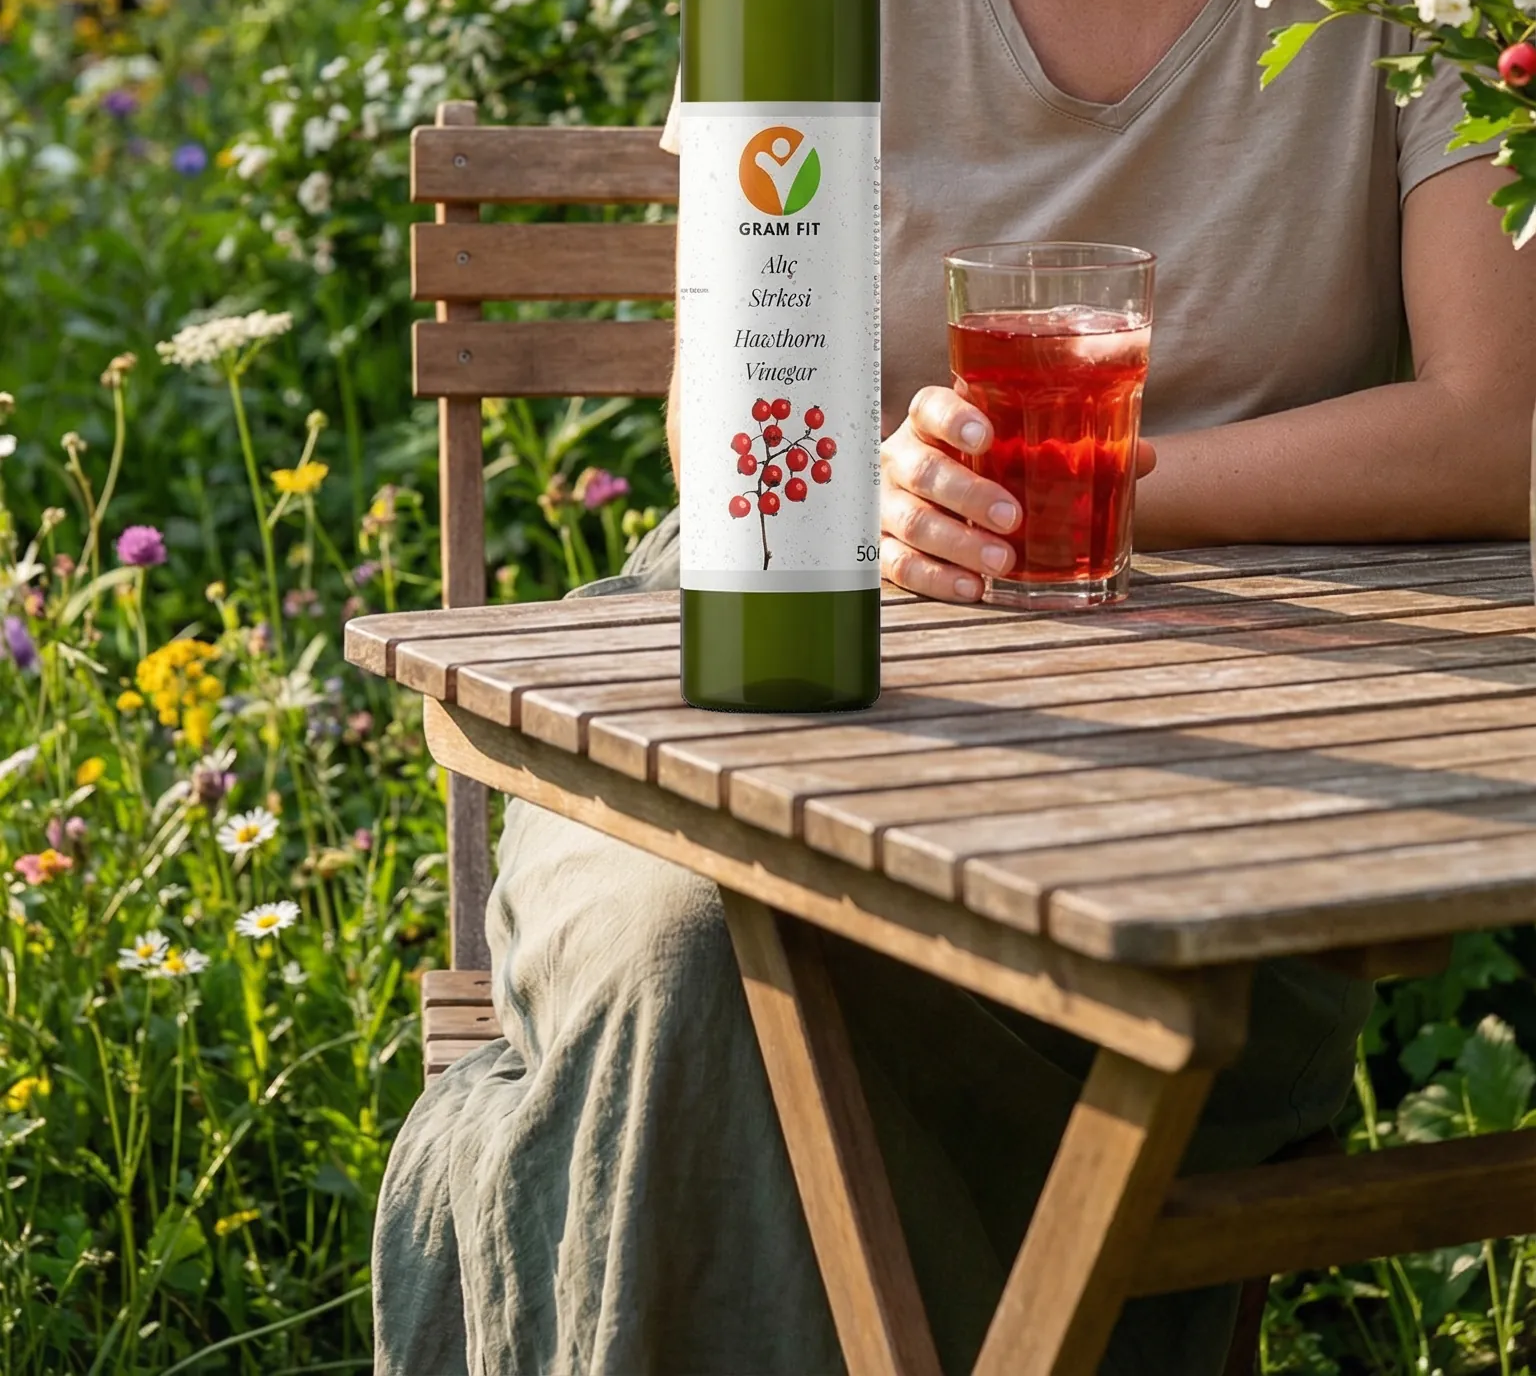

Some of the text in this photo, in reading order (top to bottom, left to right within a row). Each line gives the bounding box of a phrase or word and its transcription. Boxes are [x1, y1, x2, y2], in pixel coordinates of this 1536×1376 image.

[739, 222, 821, 236] GRAM FIT
[761, 254, 798, 280] Alıç
[734, 328, 827, 348] Hawthorn
[856, 545, 880, 562] 50
